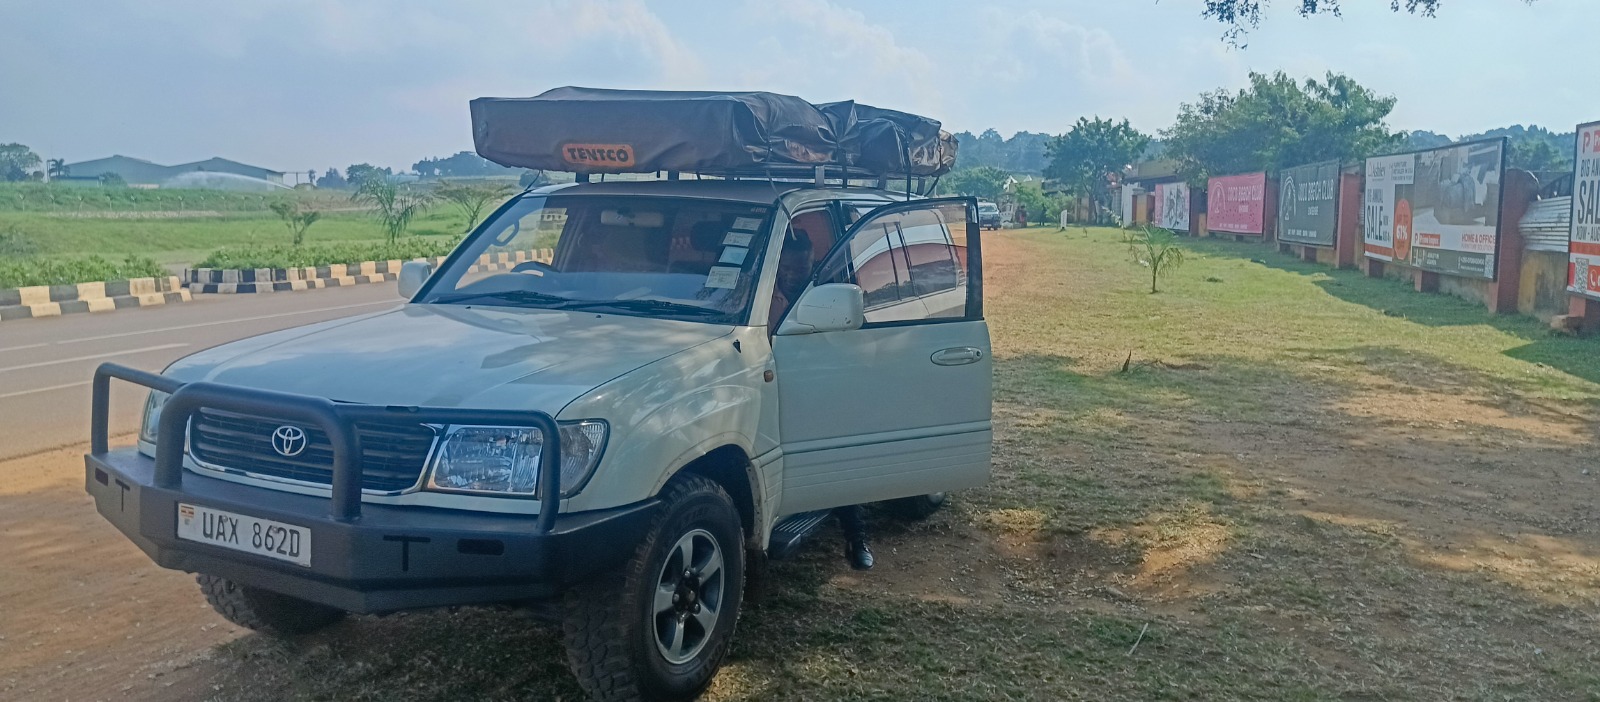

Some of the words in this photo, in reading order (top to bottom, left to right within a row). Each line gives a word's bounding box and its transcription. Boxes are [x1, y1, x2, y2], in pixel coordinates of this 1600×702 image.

[567, 148, 629, 162] TENTCO
[1580, 160, 1590, 177] BIG
[1366, 205, 1384, 241] SALE
[1461, 233, 1475, 243] HOME
[202, 511, 239, 545] UAX
[252, 522, 300, 557] 862D
